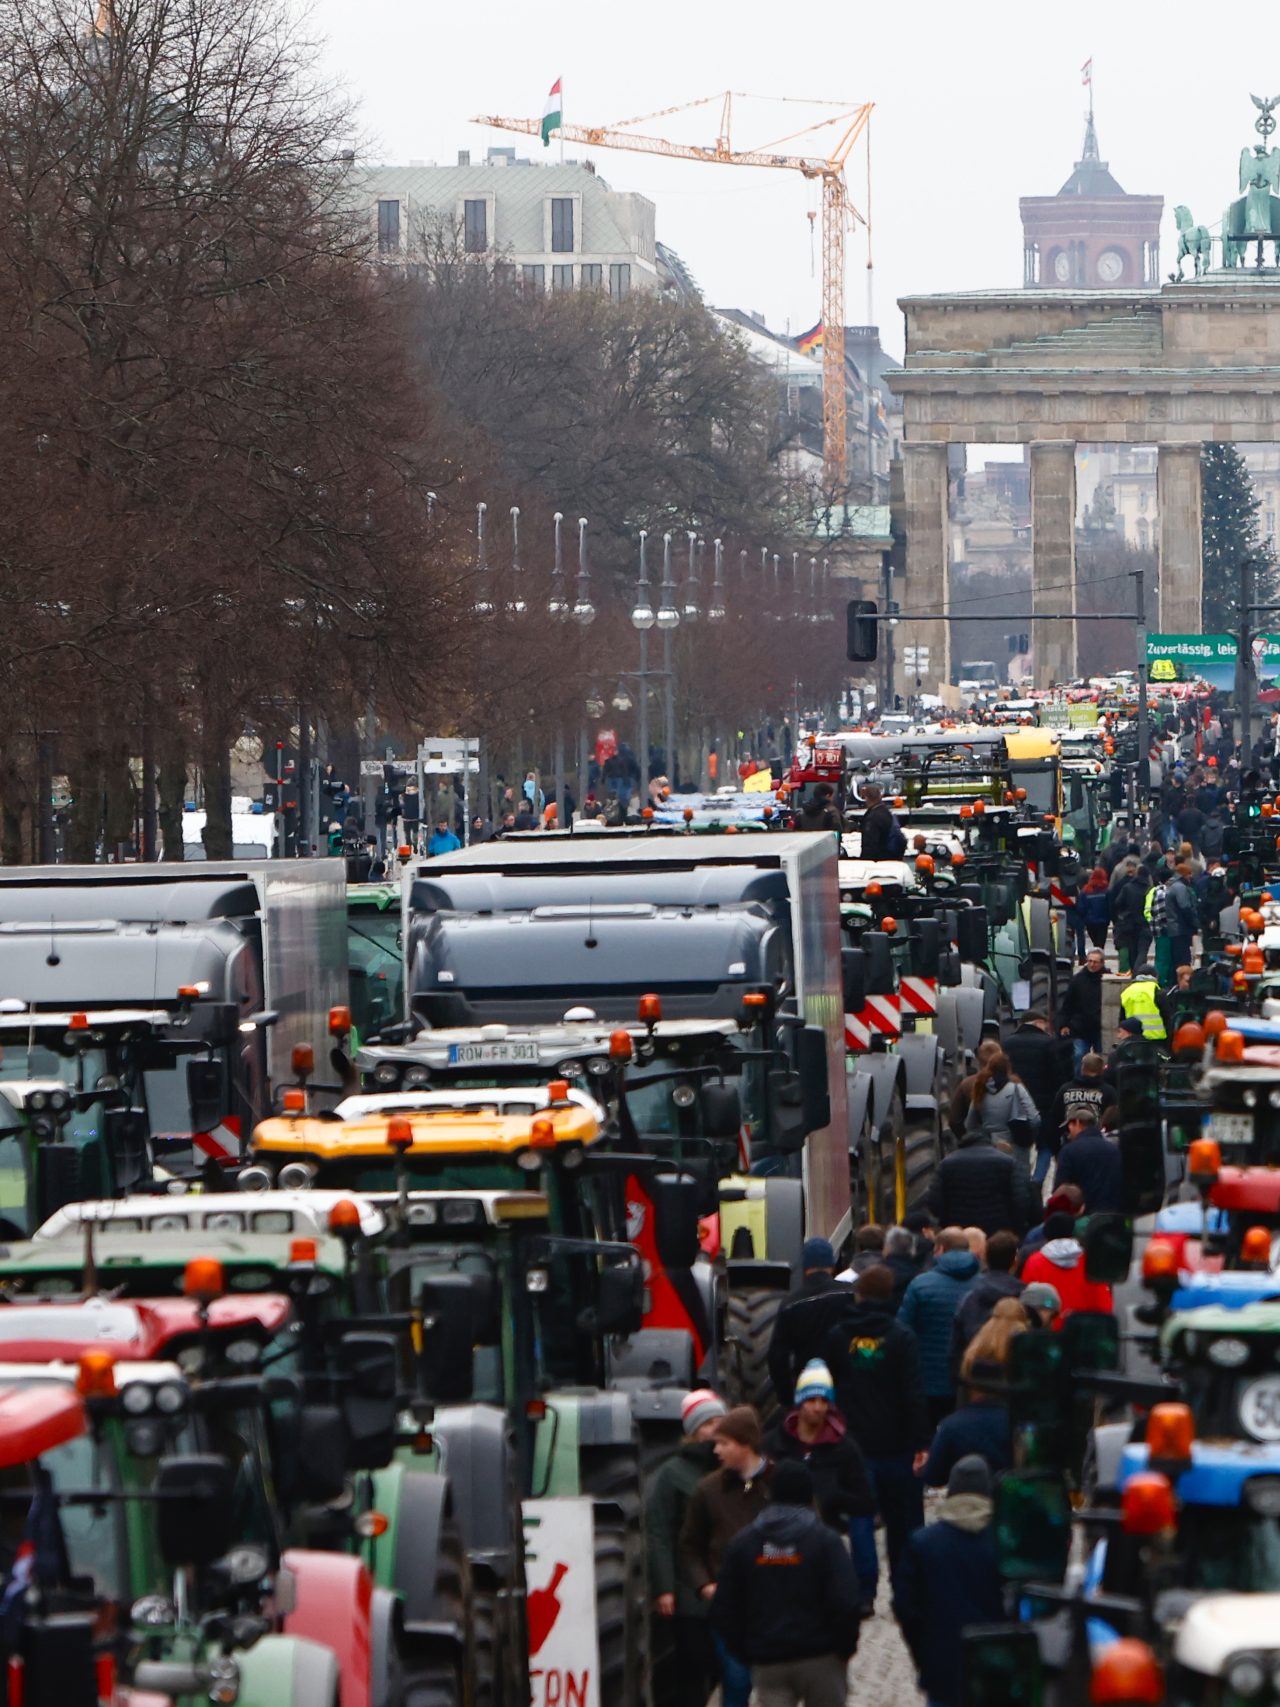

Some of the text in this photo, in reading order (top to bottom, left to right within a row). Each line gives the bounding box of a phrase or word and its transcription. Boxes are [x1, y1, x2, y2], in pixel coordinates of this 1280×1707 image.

[1147, 643, 1214, 657] Zuverlässig,
[458, 1044, 535, 1061] ROW FH 301
[1063, 1090, 1103, 1105] BERNER
